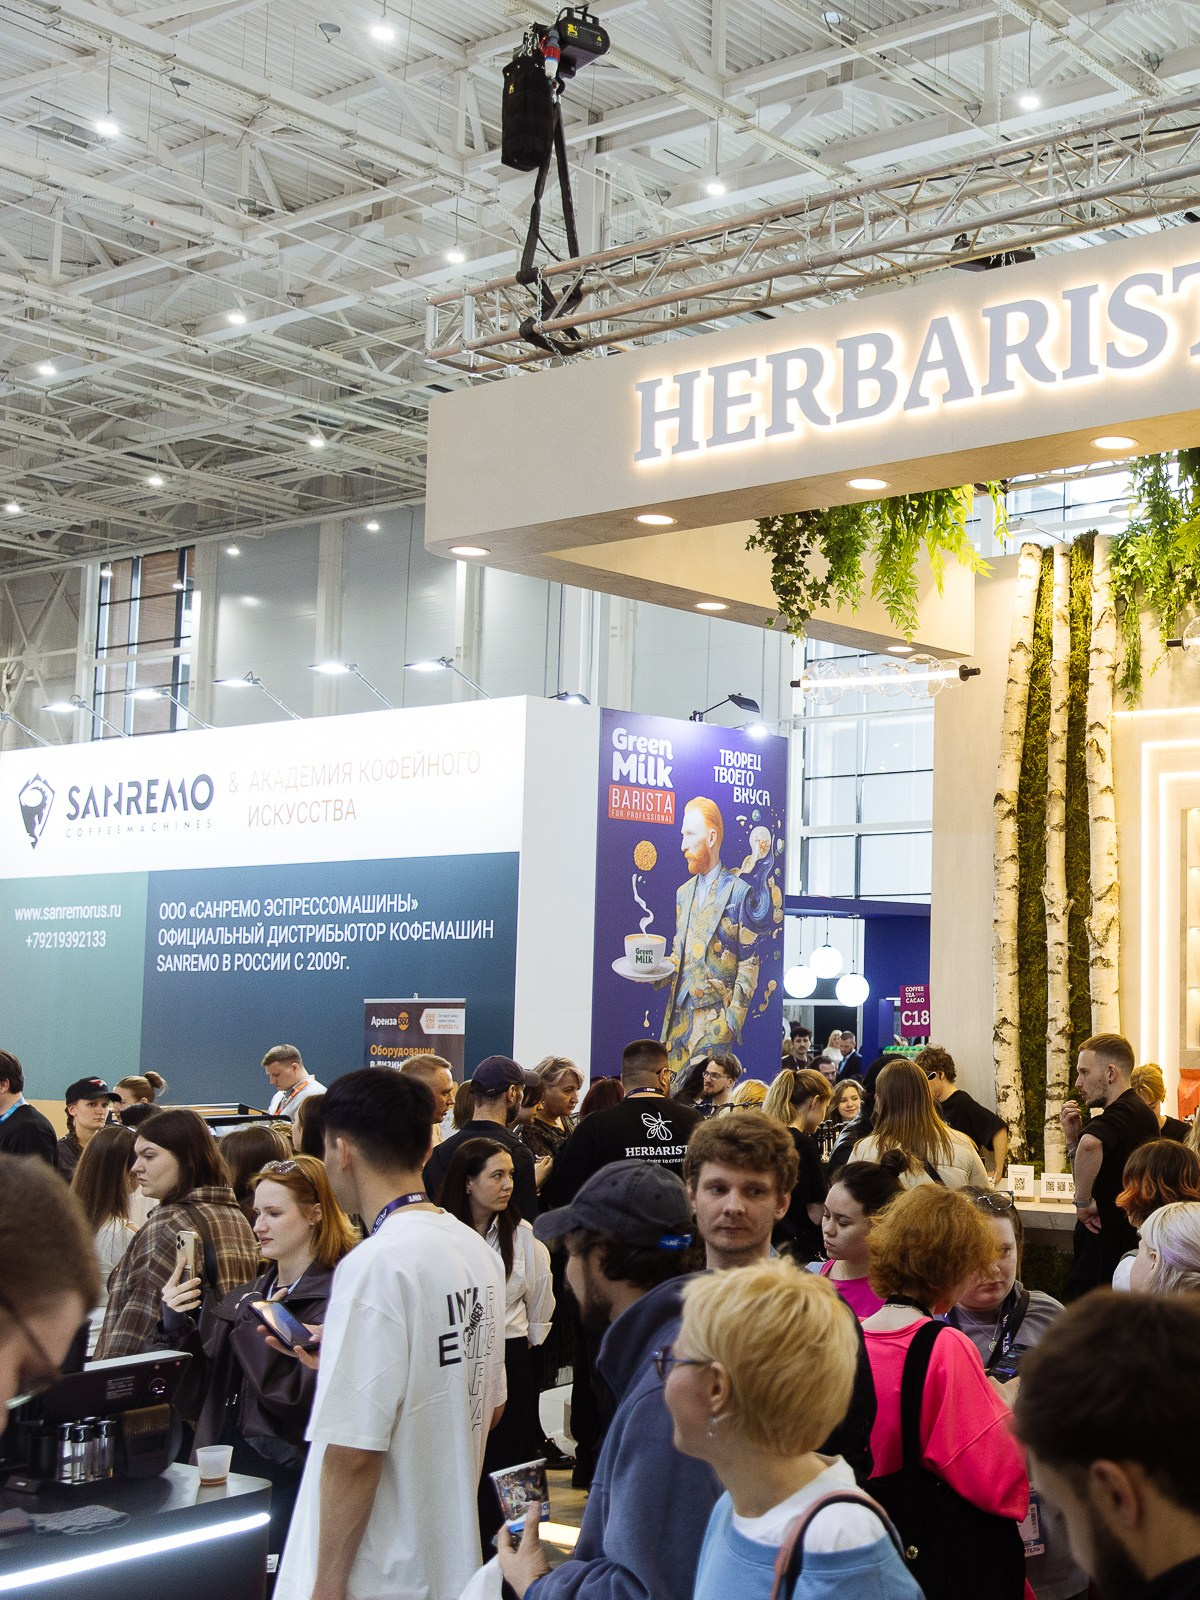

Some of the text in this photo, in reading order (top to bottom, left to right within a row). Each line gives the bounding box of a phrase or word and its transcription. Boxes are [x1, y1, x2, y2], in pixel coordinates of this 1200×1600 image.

[612, 728, 673, 760] Green
[612, 751, 673, 788] Milk
[719, 749, 762, 772] ТВОРЕЦ
[229, 749, 480, 793] & АКАДЕМИЯ КОФЕЙНОГО
[714, 766, 754, 787] ТВОЕГО
[66, 774, 214, 821] SANREMO
[612, 788, 673, 814] BARISTA
[733, 787, 770, 807] ВКУСА
[248, 798, 356, 827] ИСКУССТВА
[611, 809, 673, 823] FOR PROFESSIONAL
[66, 819, 211, 837] COFFEEMACHINES
[15, 904, 121, 920] www.sanremorus.ru
[159, 893, 418, 920] ООО «САНРЕМО ЭСПРЕССОМАШИНЫ»
[26, 930, 106, 949] +79219392133
[158, 920, 494, 949] ОФИЦИАЛЬНЫЙ ДИСТРИБЬЮТОР КОФЕМАШИН
[635, 947, 653, 956] Green
[635, 955, 653, 964] Milk
[157, 952, 350, 972] SANREMO В РОССИИ С 2009г.
[371, 1016, 397, 1027] Аренза
[902, 1010, 930, 1025] C18
[370, 1044, 435, 1057] Оборудование
[625, 1145, 690, 1157] HERBARIST
